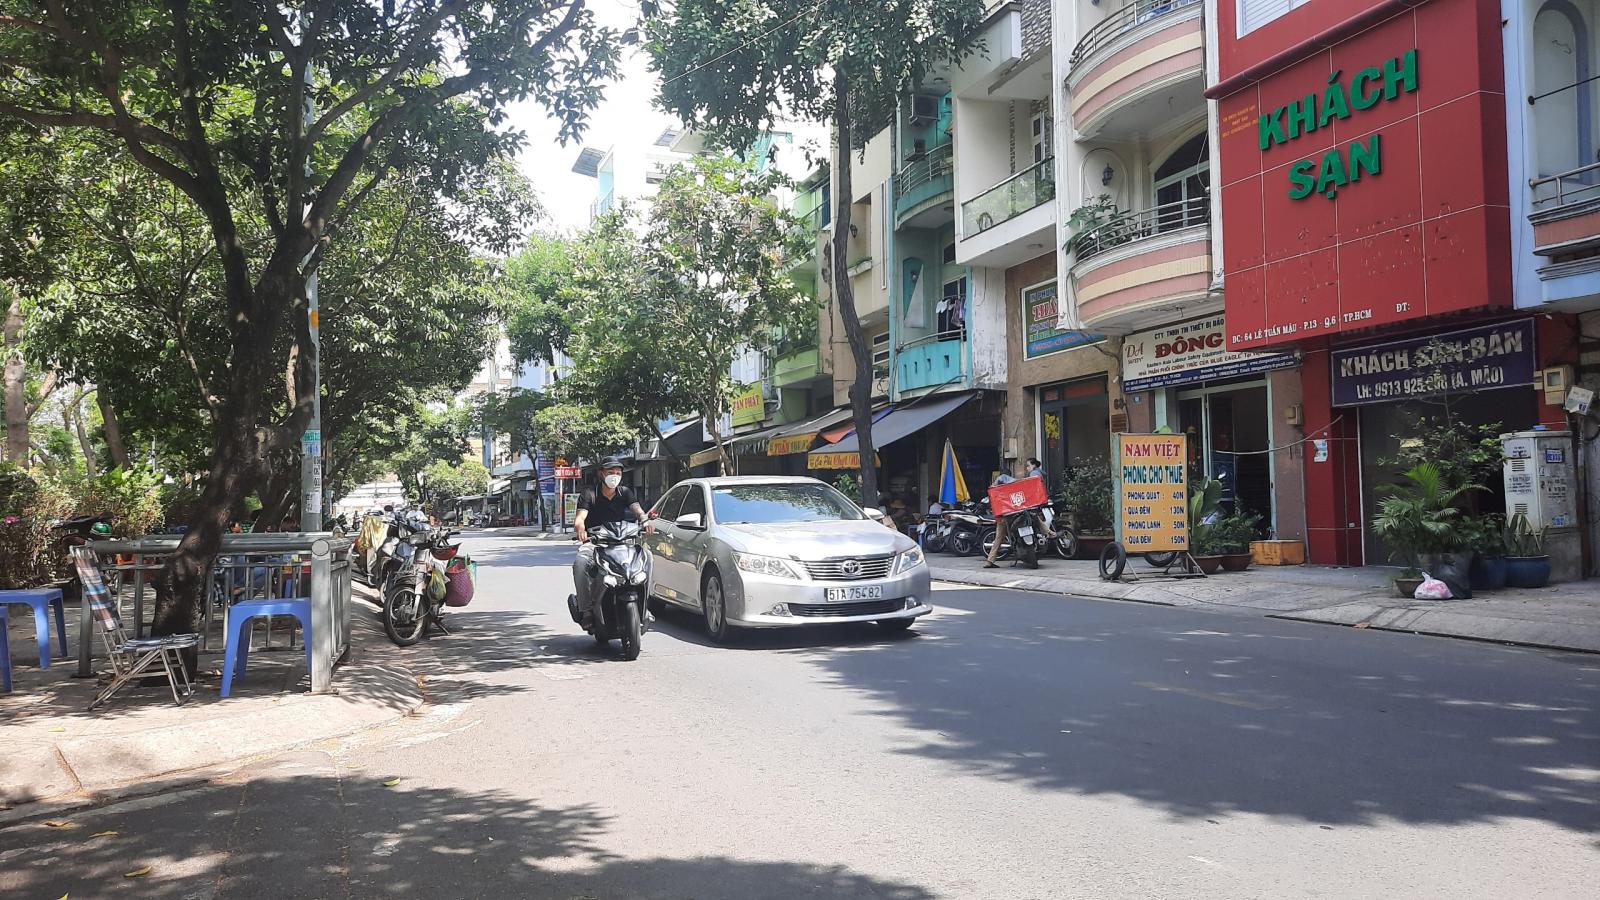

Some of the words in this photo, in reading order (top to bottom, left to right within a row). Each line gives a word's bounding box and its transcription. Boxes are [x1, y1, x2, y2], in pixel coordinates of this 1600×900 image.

[1257, 48, 1419, 152] KHÁCH
[1287, 133, 1382, 200] SẠN
[1396, 302, 1411, 313] ĐT:
[1244, 332, 1253, 341] 64
[1303, 320, 1318, 331] P.13
[1324, 316, 1337, 329] Q.6
[1343, 309, 1372, 323] TP.HCM
[1154, 332, 1225, 358] ĐÔNG
[1340, 349, 1409, 377] KHÁCH
[1469, 330, 1523, 359] BÁN
[1356, 383, 1372, 399] LH:
[1374, 380, 1401, 397] 0913
[1125, 443, 1152, 457] NAM
[1154, 441, 1180, 460] VIỆT
[1123, 460, 1147, 484] PHÒNG
[1148, 465, 1163, 483] CHO
[1165, 461, 1184, 483] THUÊ
[1128, 507, 1138, 515] QUA
[1129, 537, 1139, 545] QUA
[829, 588, 847, 601] 51A
